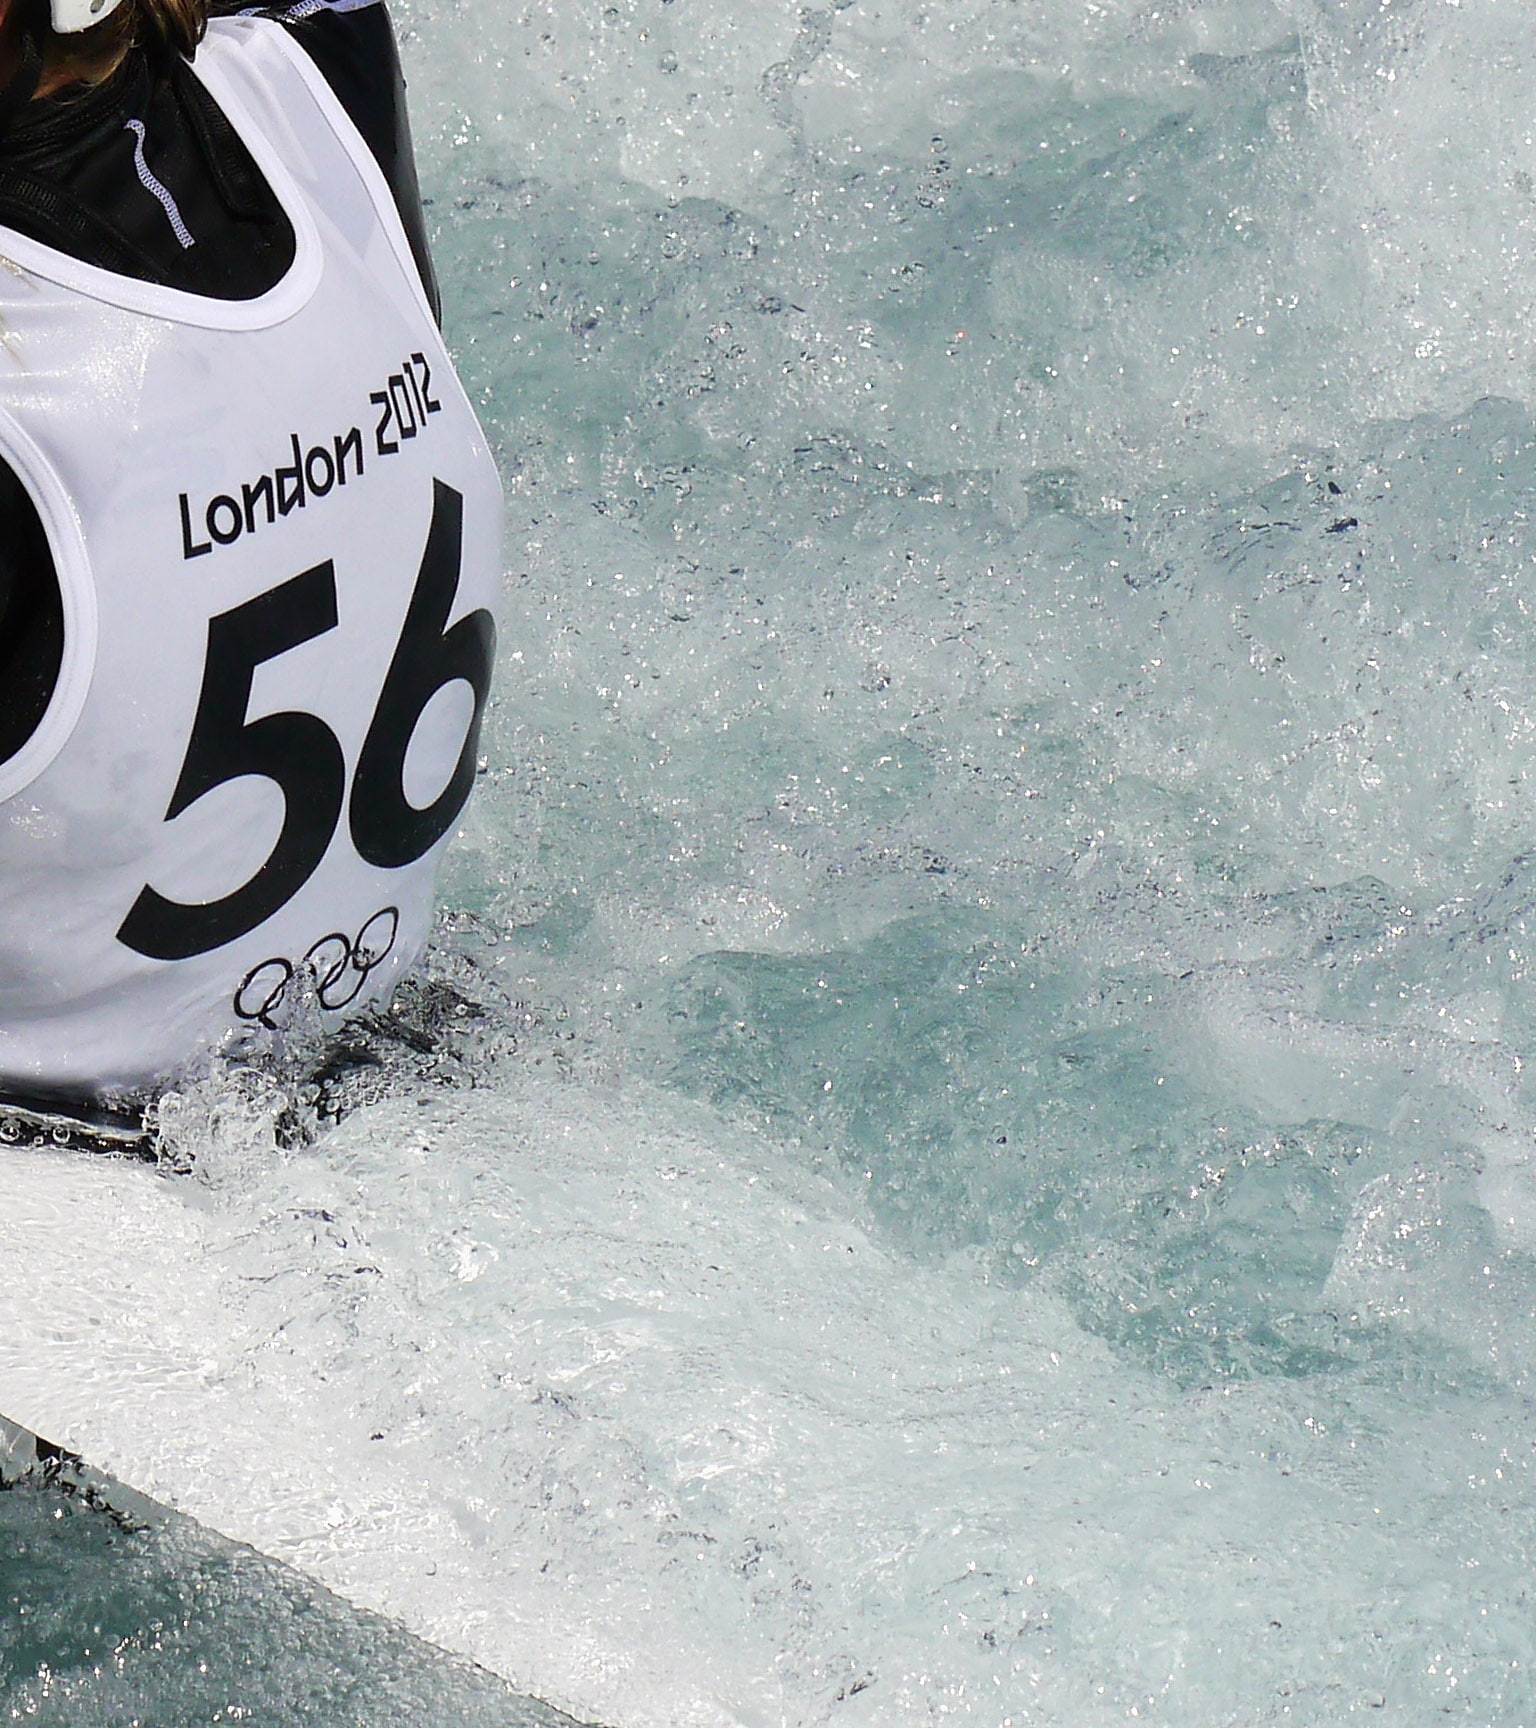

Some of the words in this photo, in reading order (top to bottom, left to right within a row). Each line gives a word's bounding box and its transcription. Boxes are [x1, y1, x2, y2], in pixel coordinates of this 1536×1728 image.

[179, 427, 364, 560] London
[369, 352, 442, 455] 2012
[115, 477, 497, 961] 56
